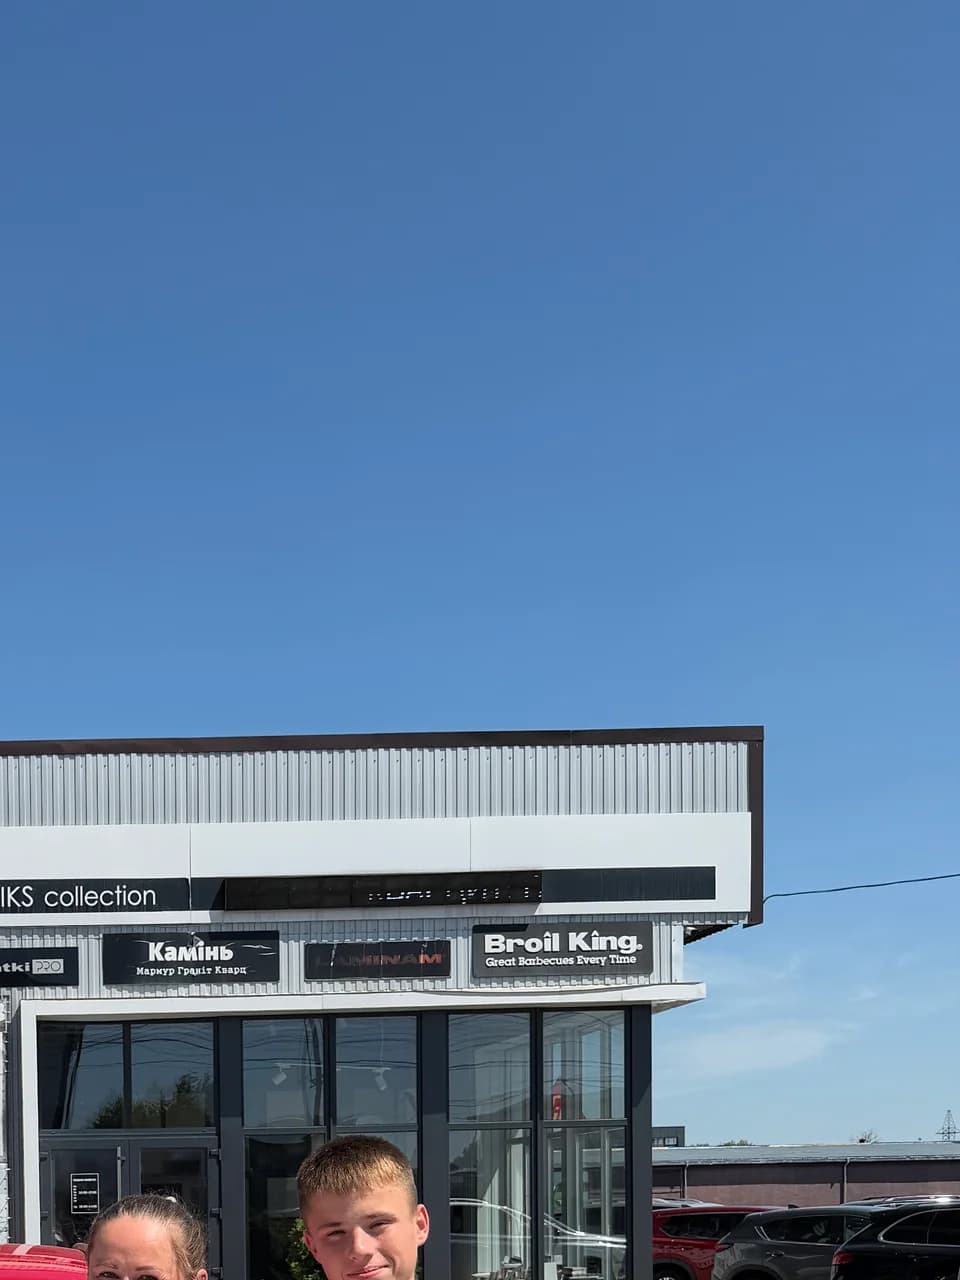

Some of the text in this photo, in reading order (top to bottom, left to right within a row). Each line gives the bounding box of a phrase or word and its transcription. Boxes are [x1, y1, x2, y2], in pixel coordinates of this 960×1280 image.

[43, 884, 156, 908] collection
[148, 940, 233, 961] Камінь
[484, 931, 560, 953] Broil
[34, 960, 61, 972] PRO
[485, 954, 637, 967] Great Barbecues Every Time
[136, 966, 247, 976] Мармур Граніт Кварц
